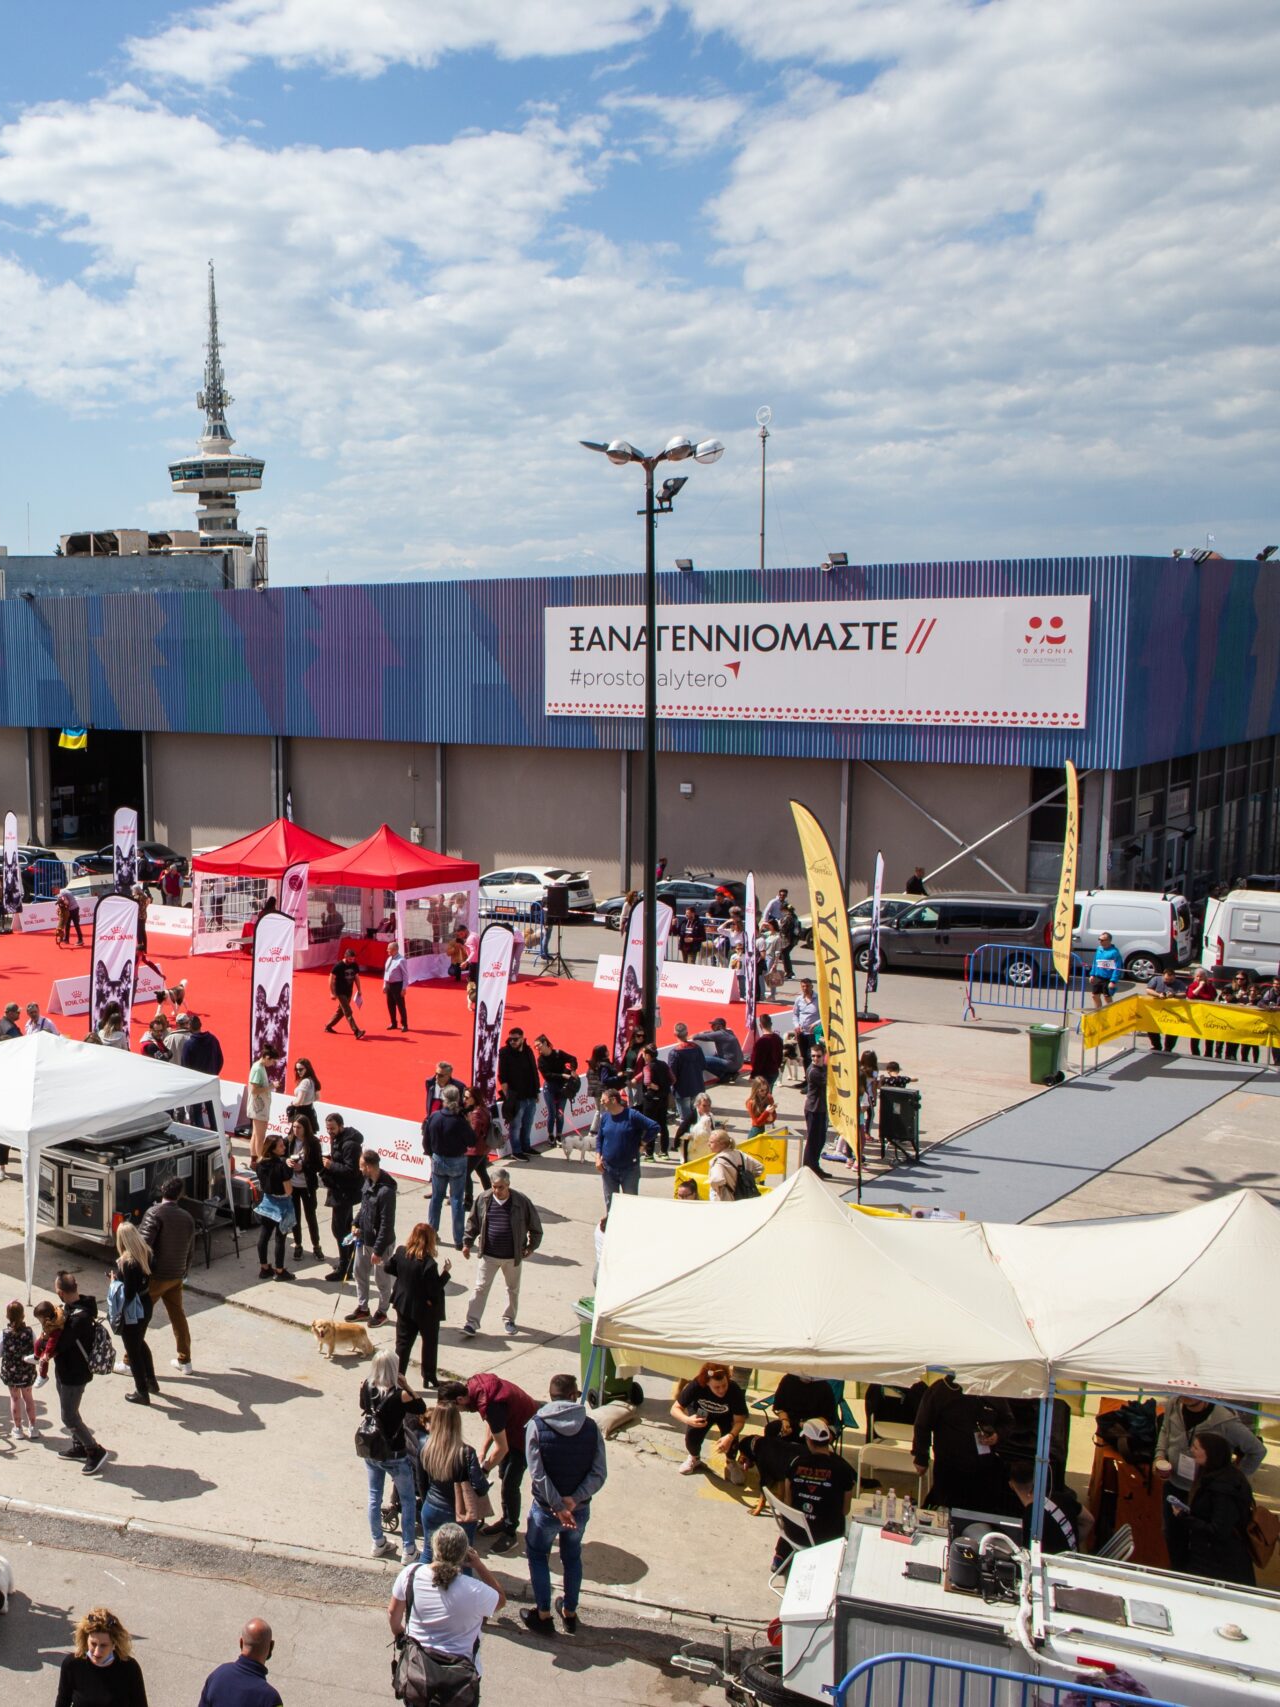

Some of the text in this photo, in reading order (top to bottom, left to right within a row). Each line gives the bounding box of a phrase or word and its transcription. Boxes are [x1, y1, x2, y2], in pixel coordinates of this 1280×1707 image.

[569, 668, 728, 691] #prostoalytero
[688, 985, 706, 993] ROYAL
[267, 1123, 282, 1131] OYAL
[377, 1147, 424, 1166] ROYAL CANIN
